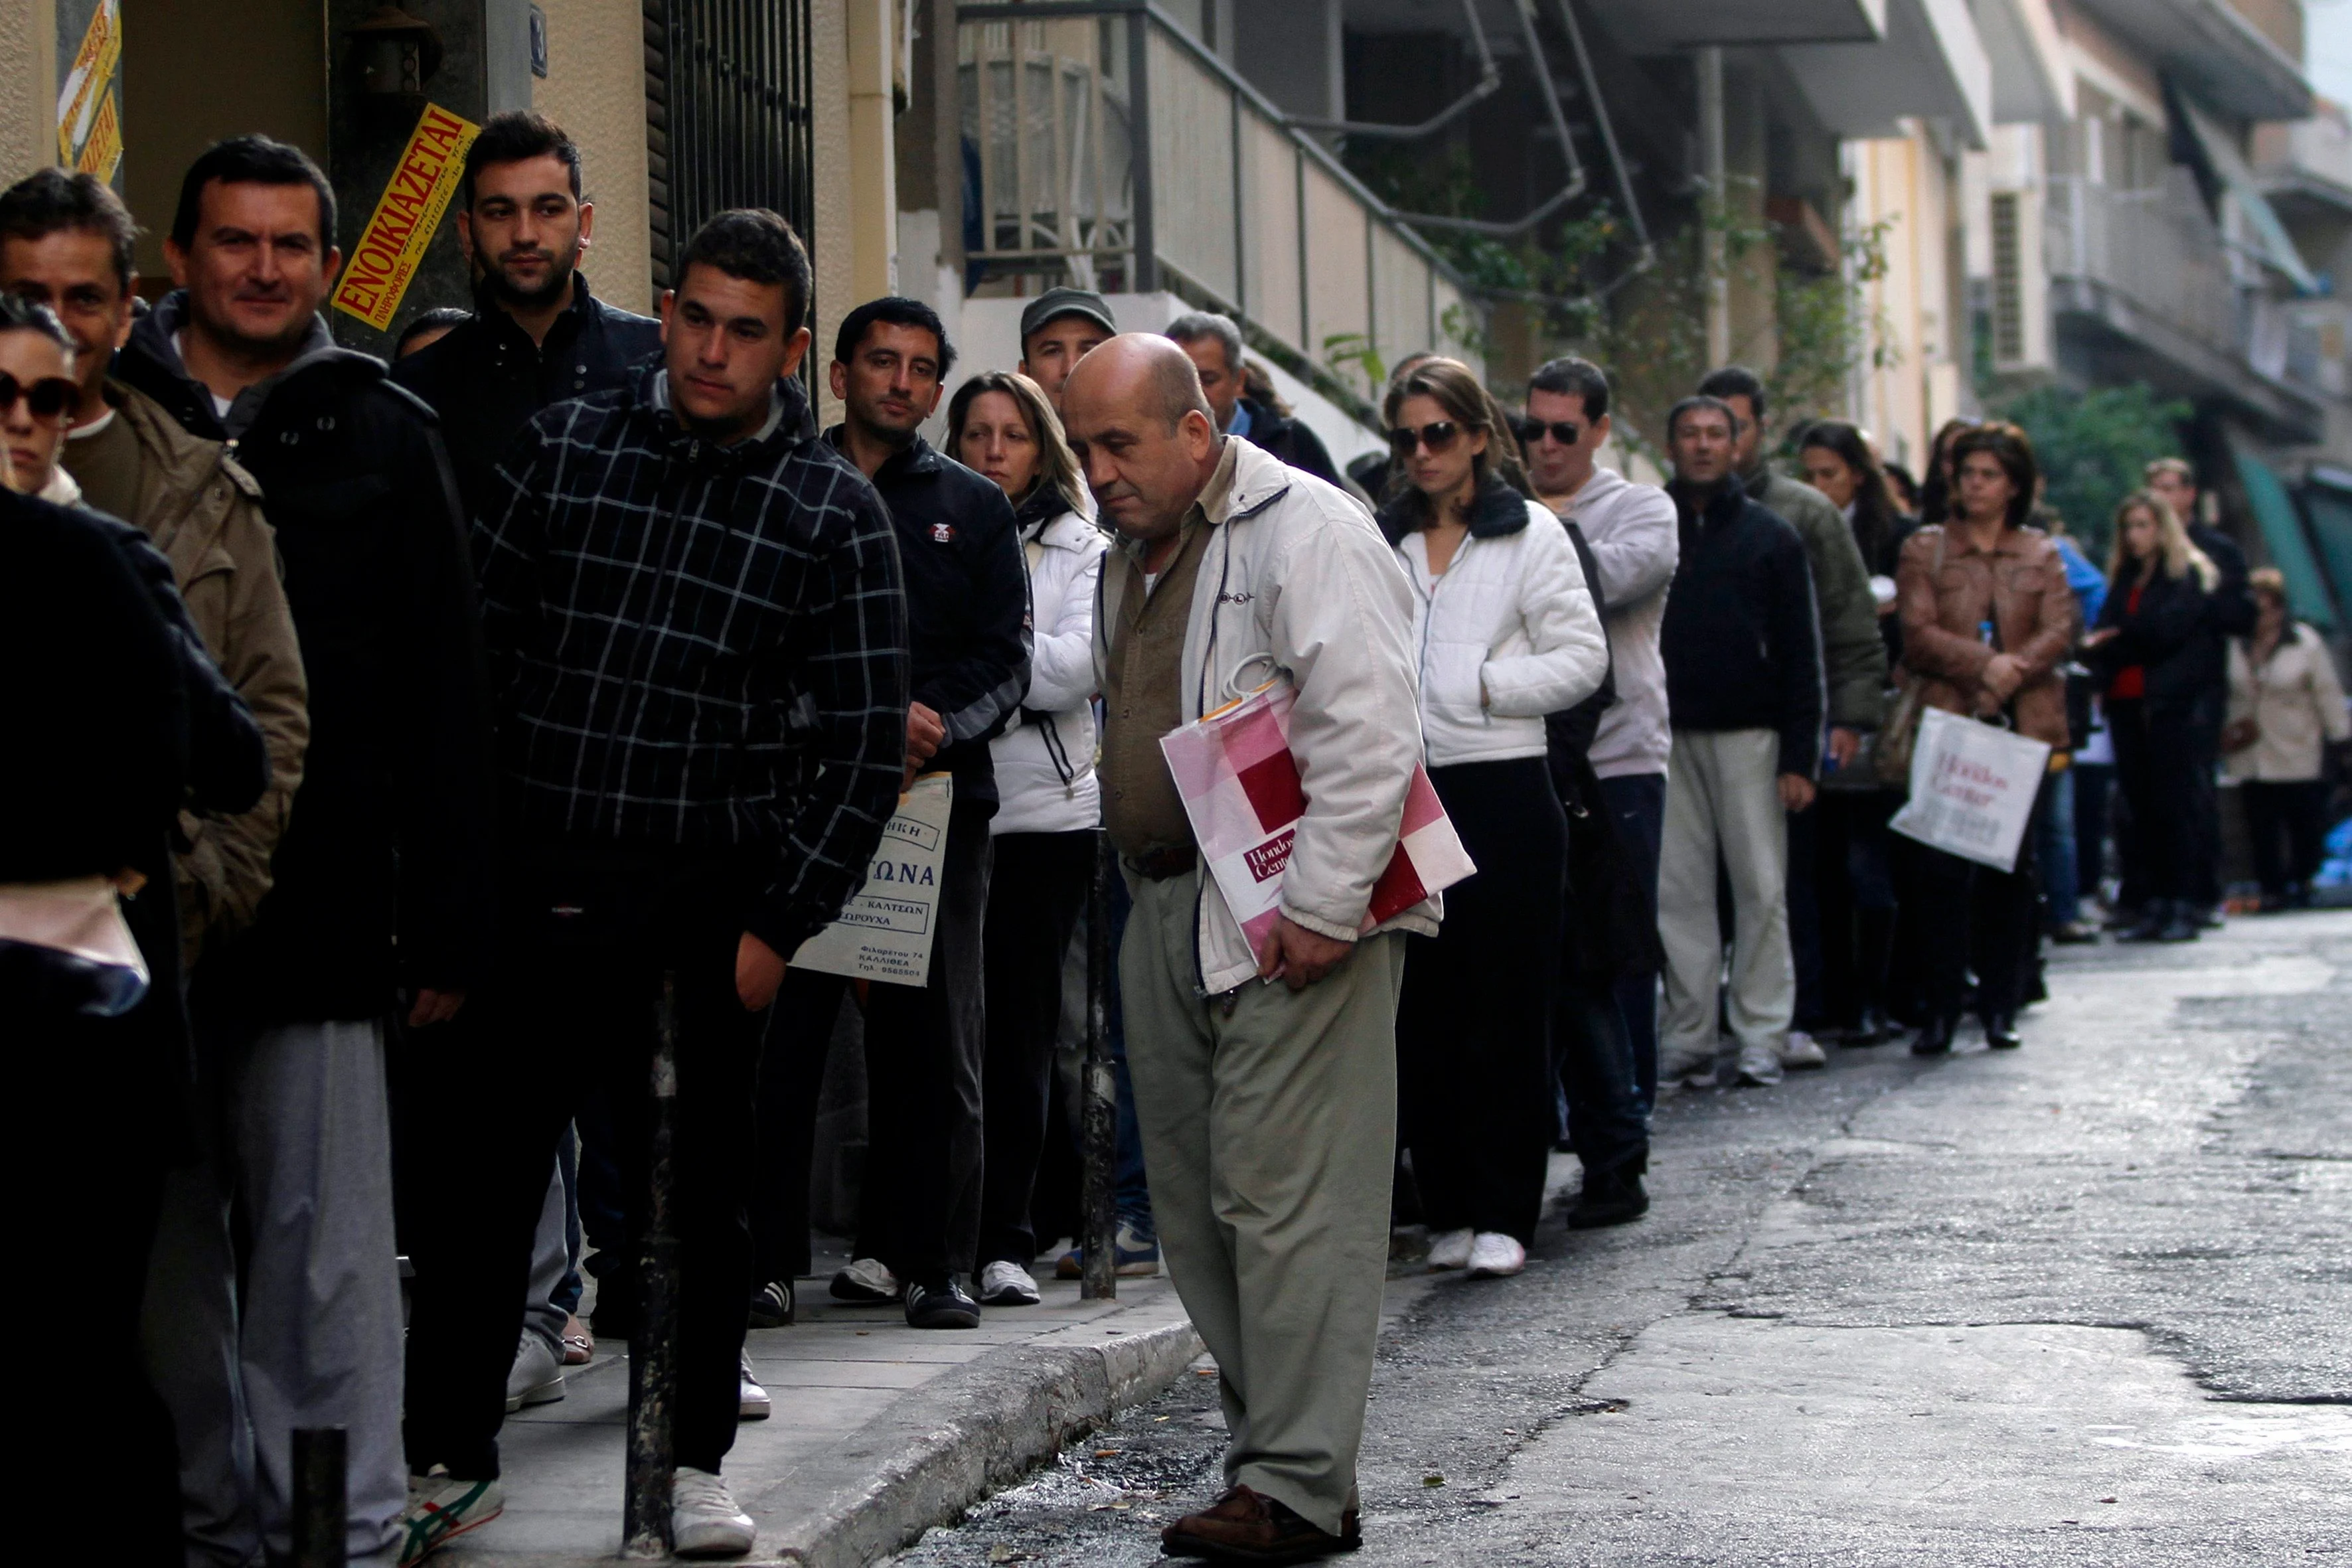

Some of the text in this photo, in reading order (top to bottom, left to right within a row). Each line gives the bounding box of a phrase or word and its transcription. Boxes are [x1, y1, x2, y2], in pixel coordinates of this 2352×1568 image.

[337, 110, 463, 317] ΕΝΟΙΚΙΑΖΕΤΑΙ
[374, 260, 412, 323] ΠΛΗΡΟΦΟΡΙΕΣ
[869, 860, 934, 886] ΩΝΑ
[1256, 857, 1288, 878] Cent
[868, 900, 923, 915] ΚΑΛΤΣΩΝ
[859, 954, 909, 967] ΚΑΛΛΙΘΕΑ
